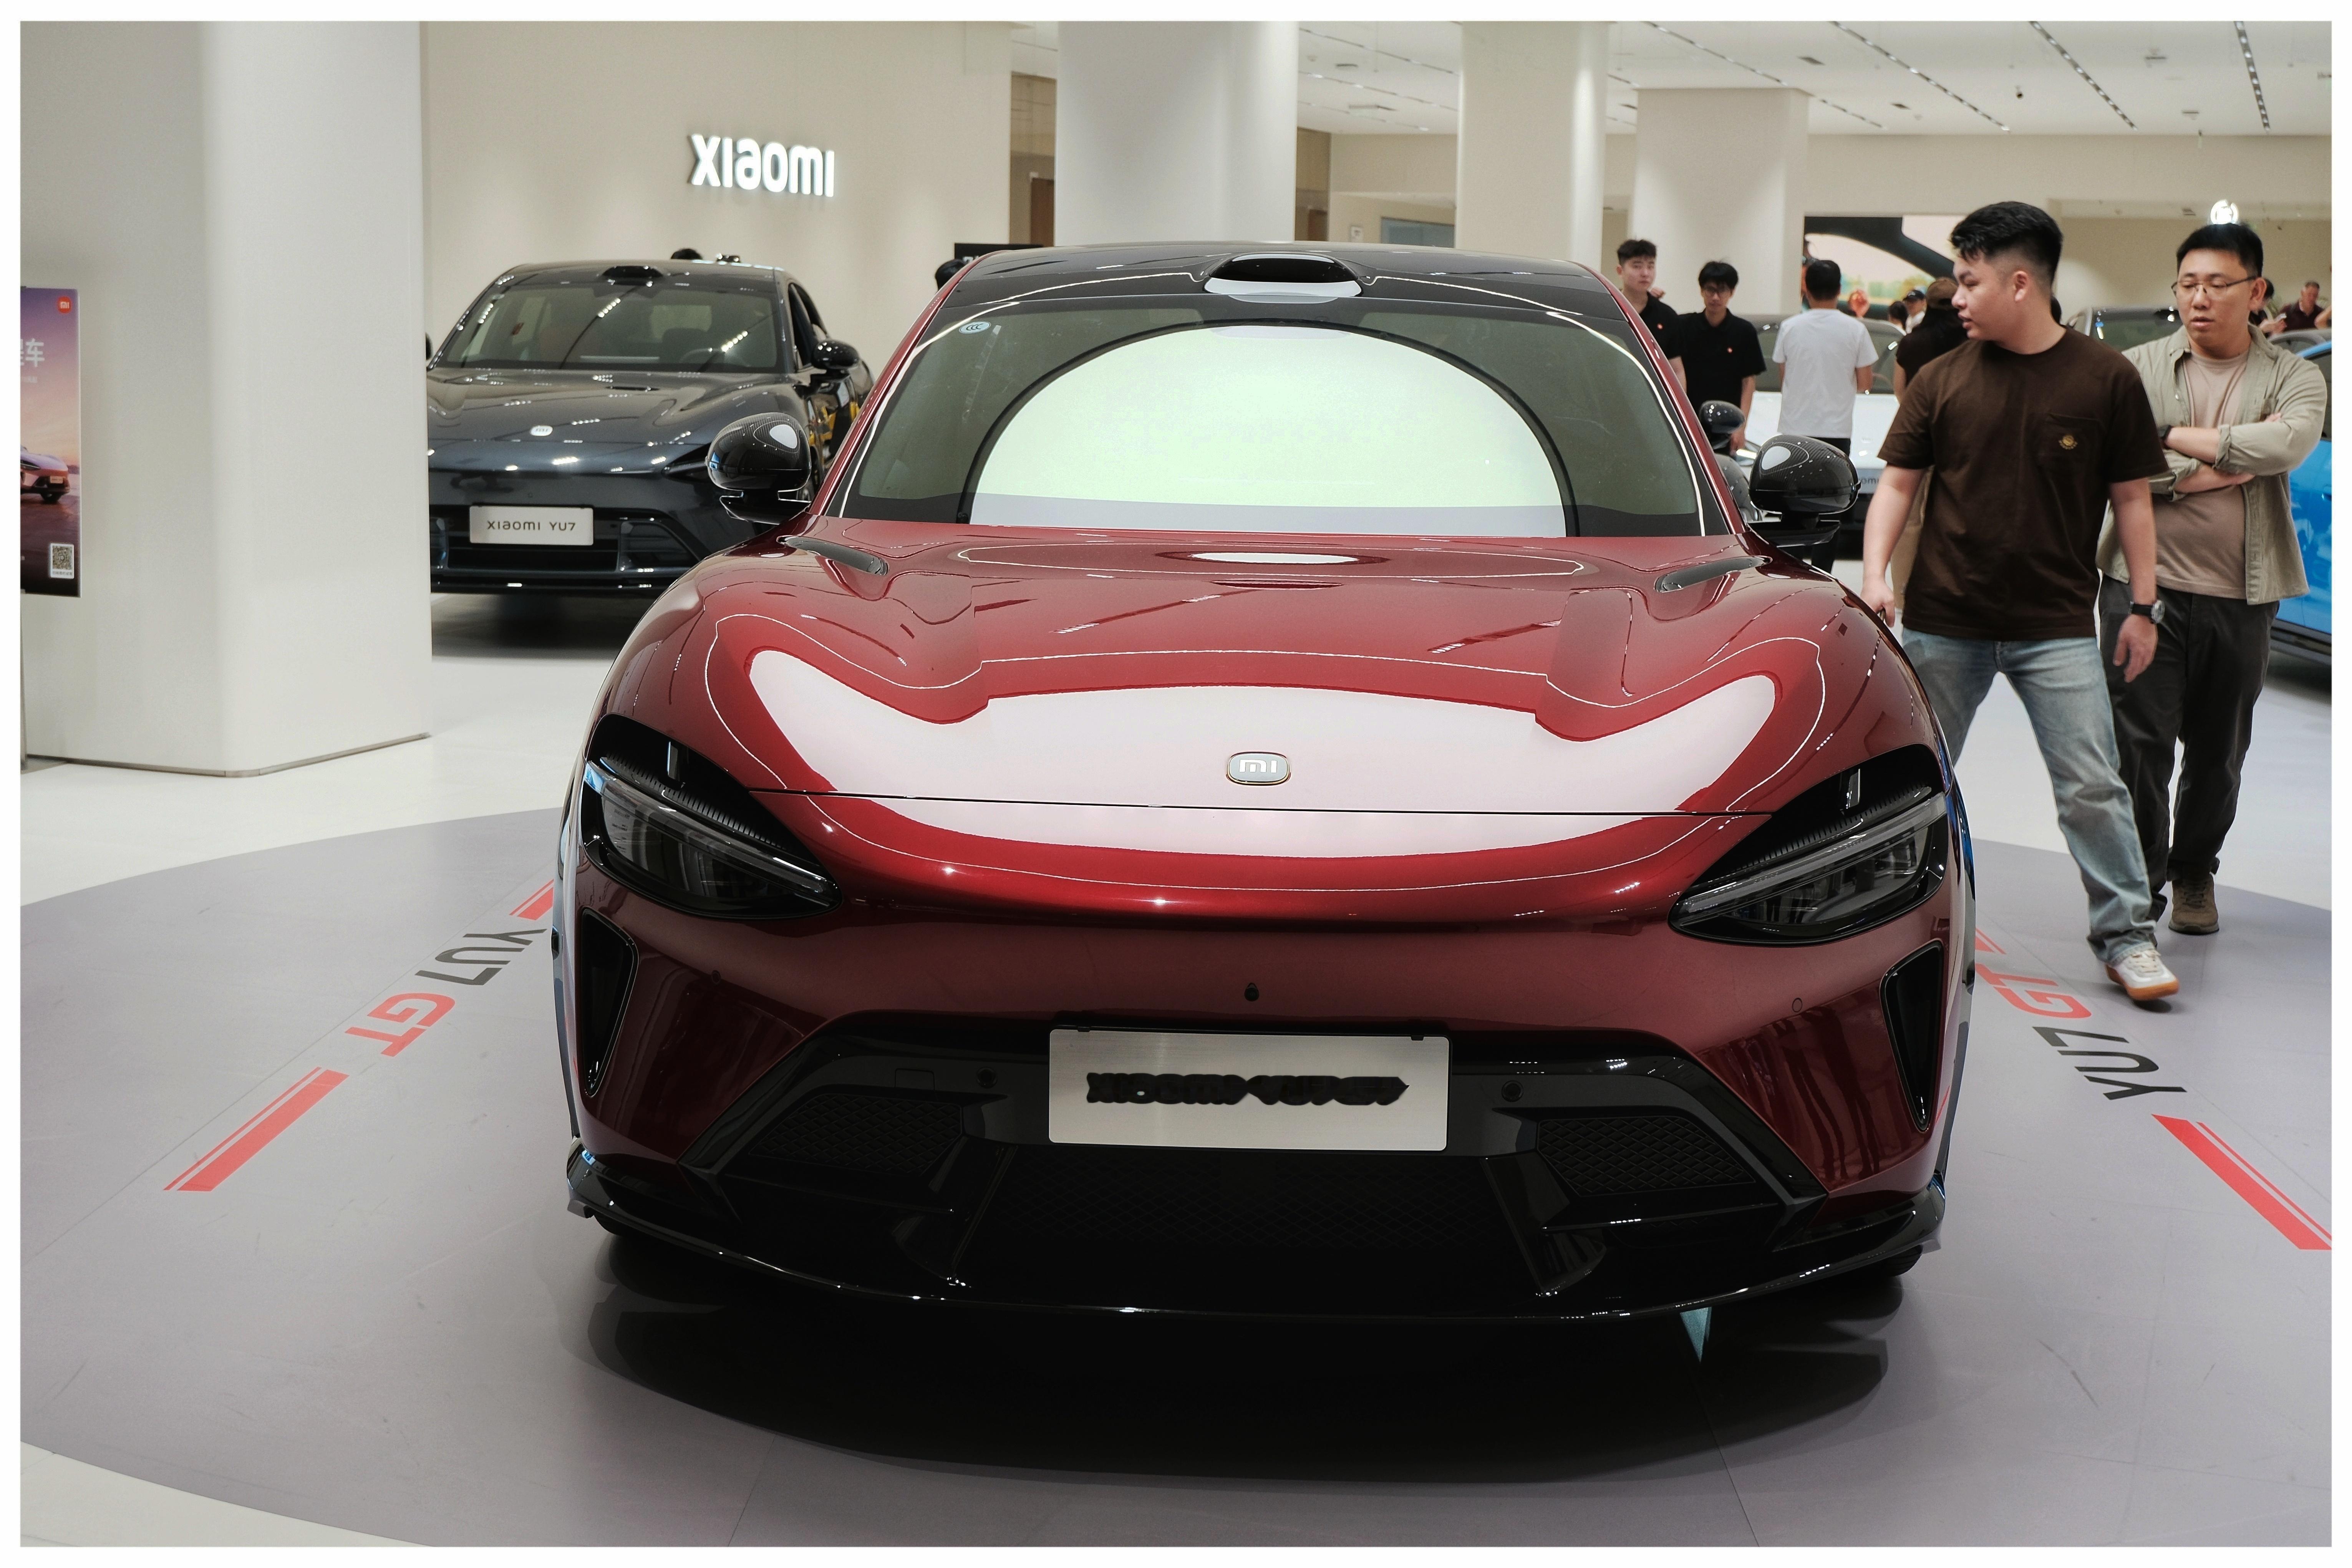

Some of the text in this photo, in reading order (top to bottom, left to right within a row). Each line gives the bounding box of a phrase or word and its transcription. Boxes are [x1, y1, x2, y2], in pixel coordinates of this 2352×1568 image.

[549, 521, 576, 532] YU7
[344, 928, 547, 1057] YU7 GT
[1974, 963, 2188, 1101] YU7 GT
